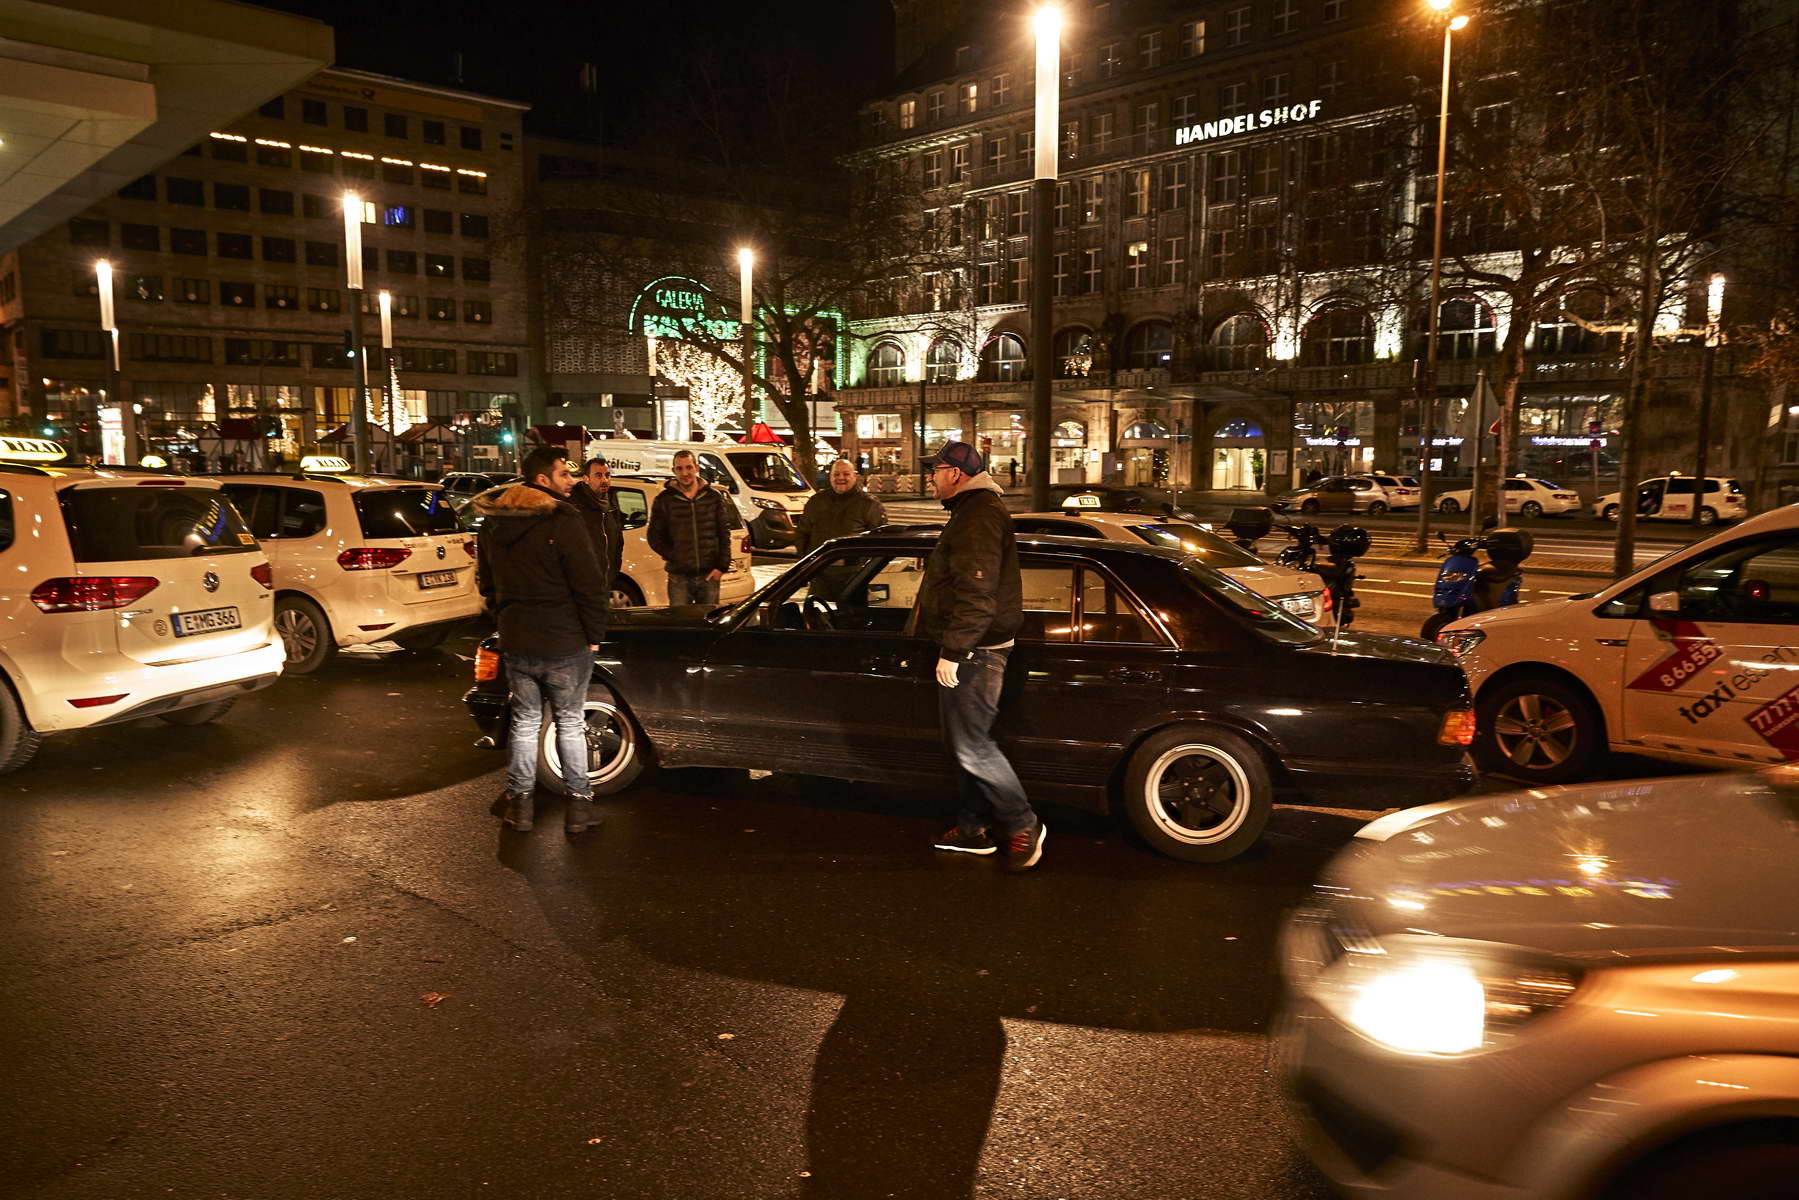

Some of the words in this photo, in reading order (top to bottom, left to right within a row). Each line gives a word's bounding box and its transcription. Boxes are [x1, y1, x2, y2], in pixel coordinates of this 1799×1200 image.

[1175, 99, 1322, 145] HANDELSHOF
[656, 289, 705, 310] GALERIA
[1659, 644, 1717, 687] 86655
[1677, 680, 1736, 724] taxi
